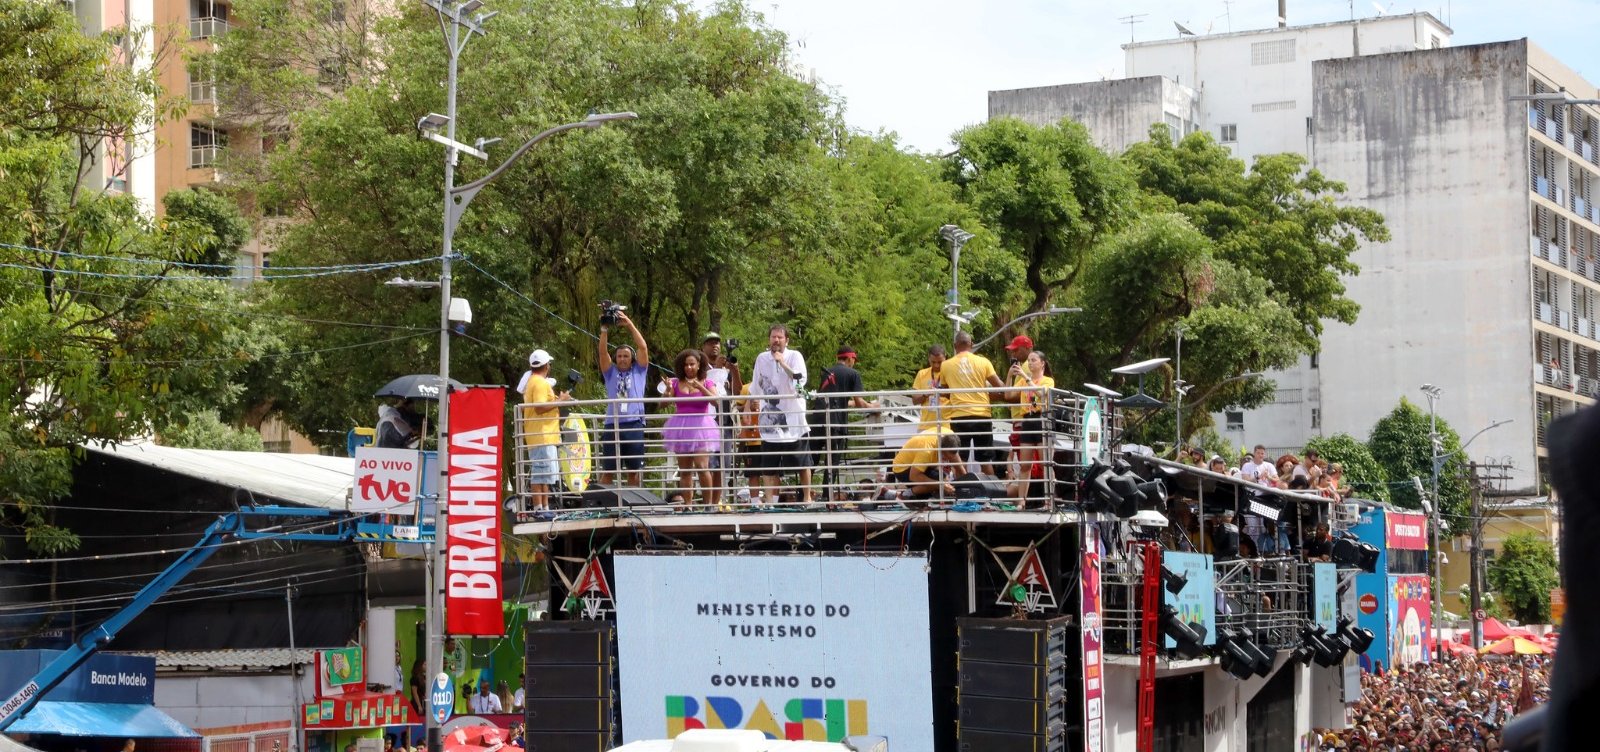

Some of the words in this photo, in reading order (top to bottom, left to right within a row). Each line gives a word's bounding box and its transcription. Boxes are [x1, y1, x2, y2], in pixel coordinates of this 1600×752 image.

[359, 459, 377, 469] AO
[382, 460, 412, 471] VIVO
[358, 474, 410, 503] tve
[449, 426, 498, 599] BRAHMA
[697, 600, 816, 617] MINISTÉRIO
[825, 604, 850, 617] DO
[729, 624, 816, 638] TURISMO
[91, 670, 117, 685] Banca
[118, 672, 147, 687] Modelo
[711, 674, 799, 688] GOVERNO
[811, 676, 836, 689] DO
[3, 684, 38, 715] 3046-1460
